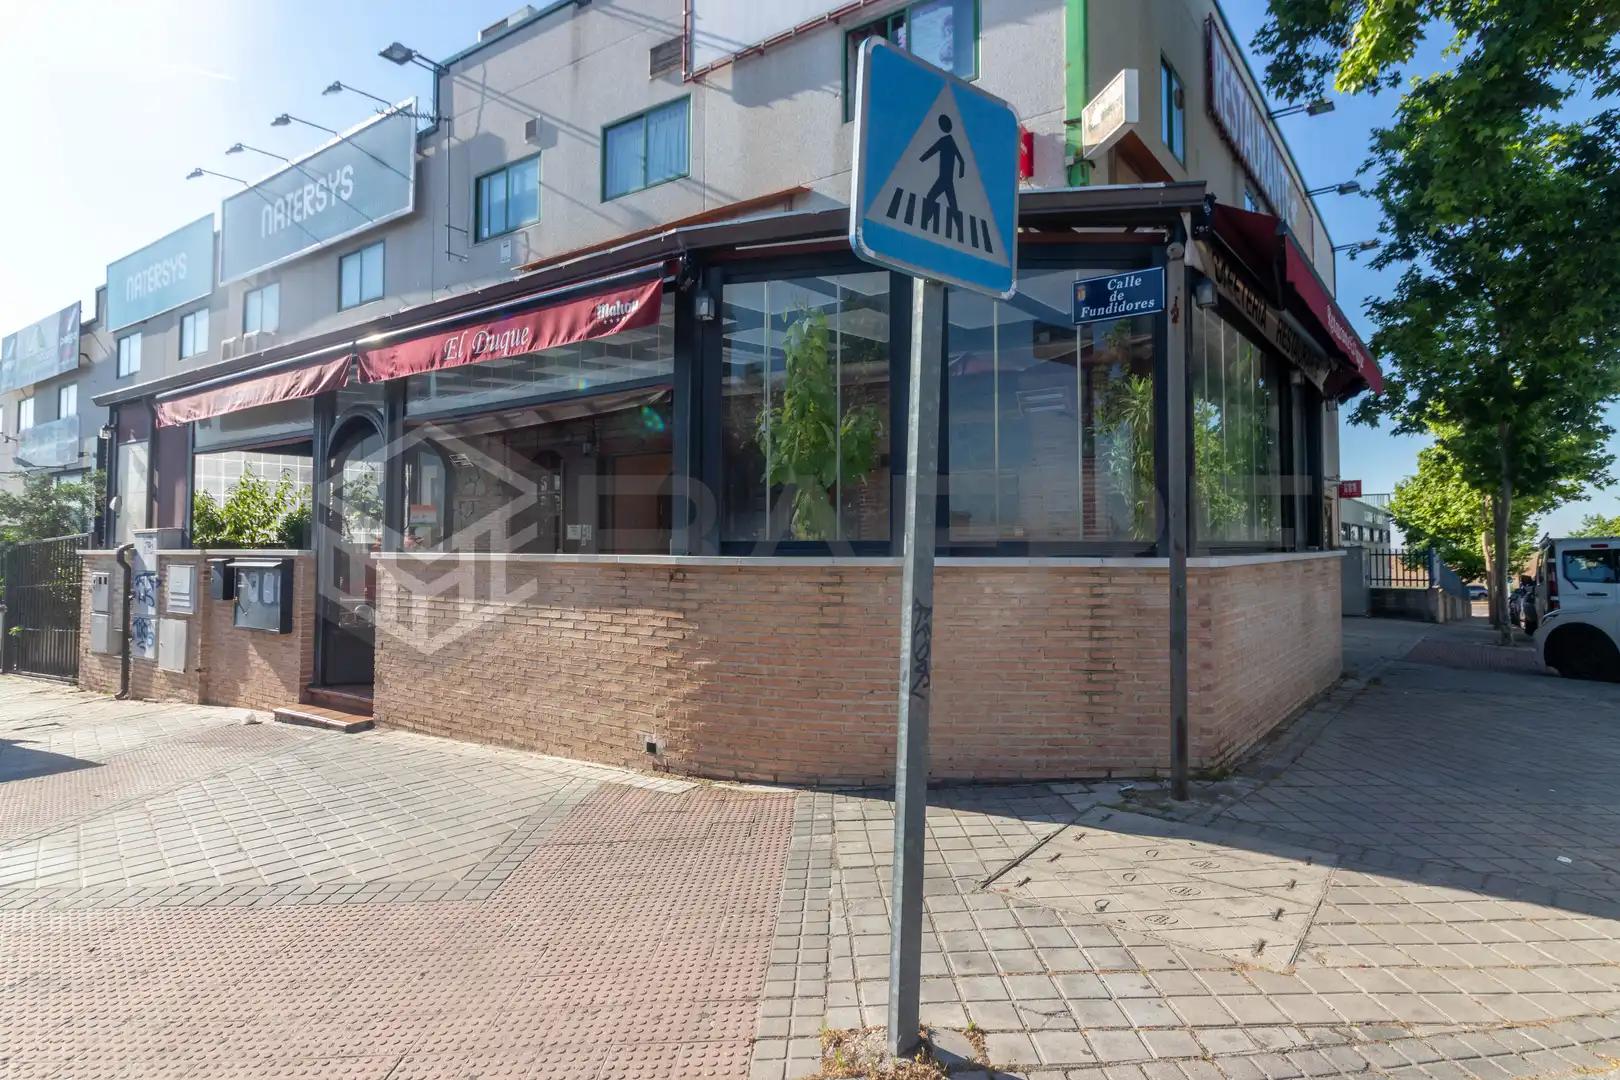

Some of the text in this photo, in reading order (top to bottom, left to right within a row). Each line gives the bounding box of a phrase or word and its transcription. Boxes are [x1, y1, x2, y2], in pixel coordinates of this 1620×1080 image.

[261, 164, 354, 239] NATERSYS
[126, 251, 188, 302] NATERSYS
[1107, 275, 1142, 291] Calle
[1080, 299, 1155, 318] Fundidores
[1108, 290, 1125, 302] de
[444, 327, 530, 360] El Duque
